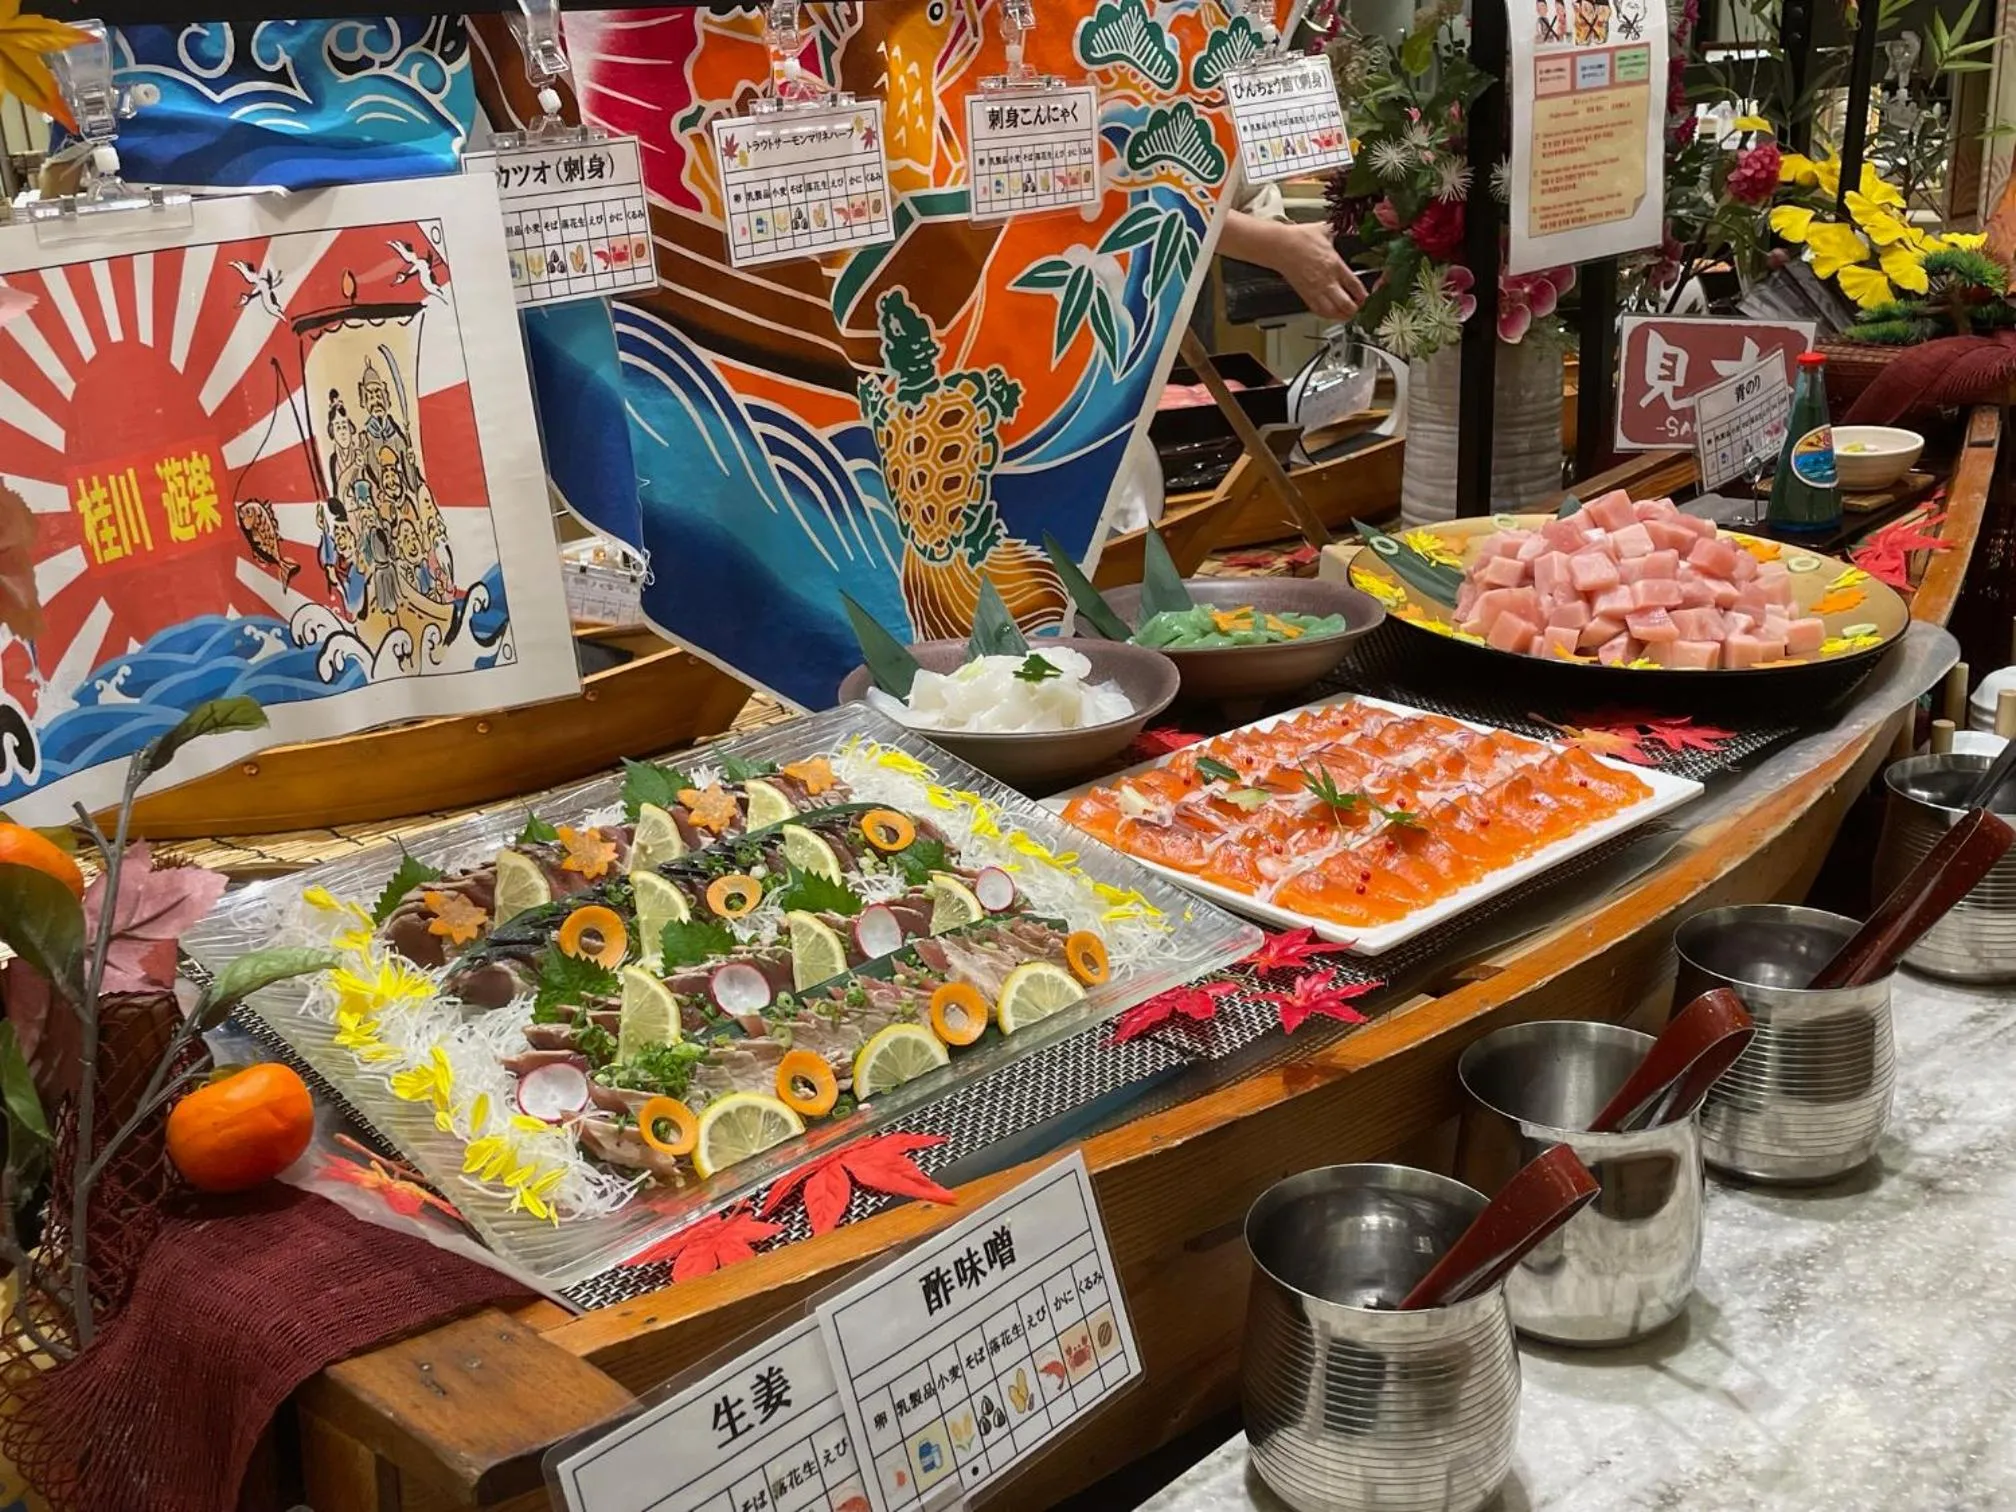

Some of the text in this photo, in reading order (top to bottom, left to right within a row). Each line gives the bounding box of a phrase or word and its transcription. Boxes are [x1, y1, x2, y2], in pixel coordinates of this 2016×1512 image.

[988, 101, 1079, 131] 刺身こんにゃく
[496, 152, 615, 189] カツオ(刺身)
[524, 222, 542, 235] 小麦
[544, 219, 559, 232] そば
[561, 216, 587, 230] 落花生
[589, 213, 605, 226] えび
[609, 211, 624, 224] かに
[626, 209, 645, 221] くるみ
[1734, 374, 1762, 403] 青のり
[76, 451, 222, 564] 桂川 遊楽
[919, 1224, 1017, 1317] 酢味噌
[873, 1270, 1104, 1431] 卵 乳製品 小麦 そば 落花生 えび かに くるみ
[711, 1366, 793, 1450] 生姜
[772, 1459, 819, 1501] 落花生
[823, 1437, 848, 1468] えび
